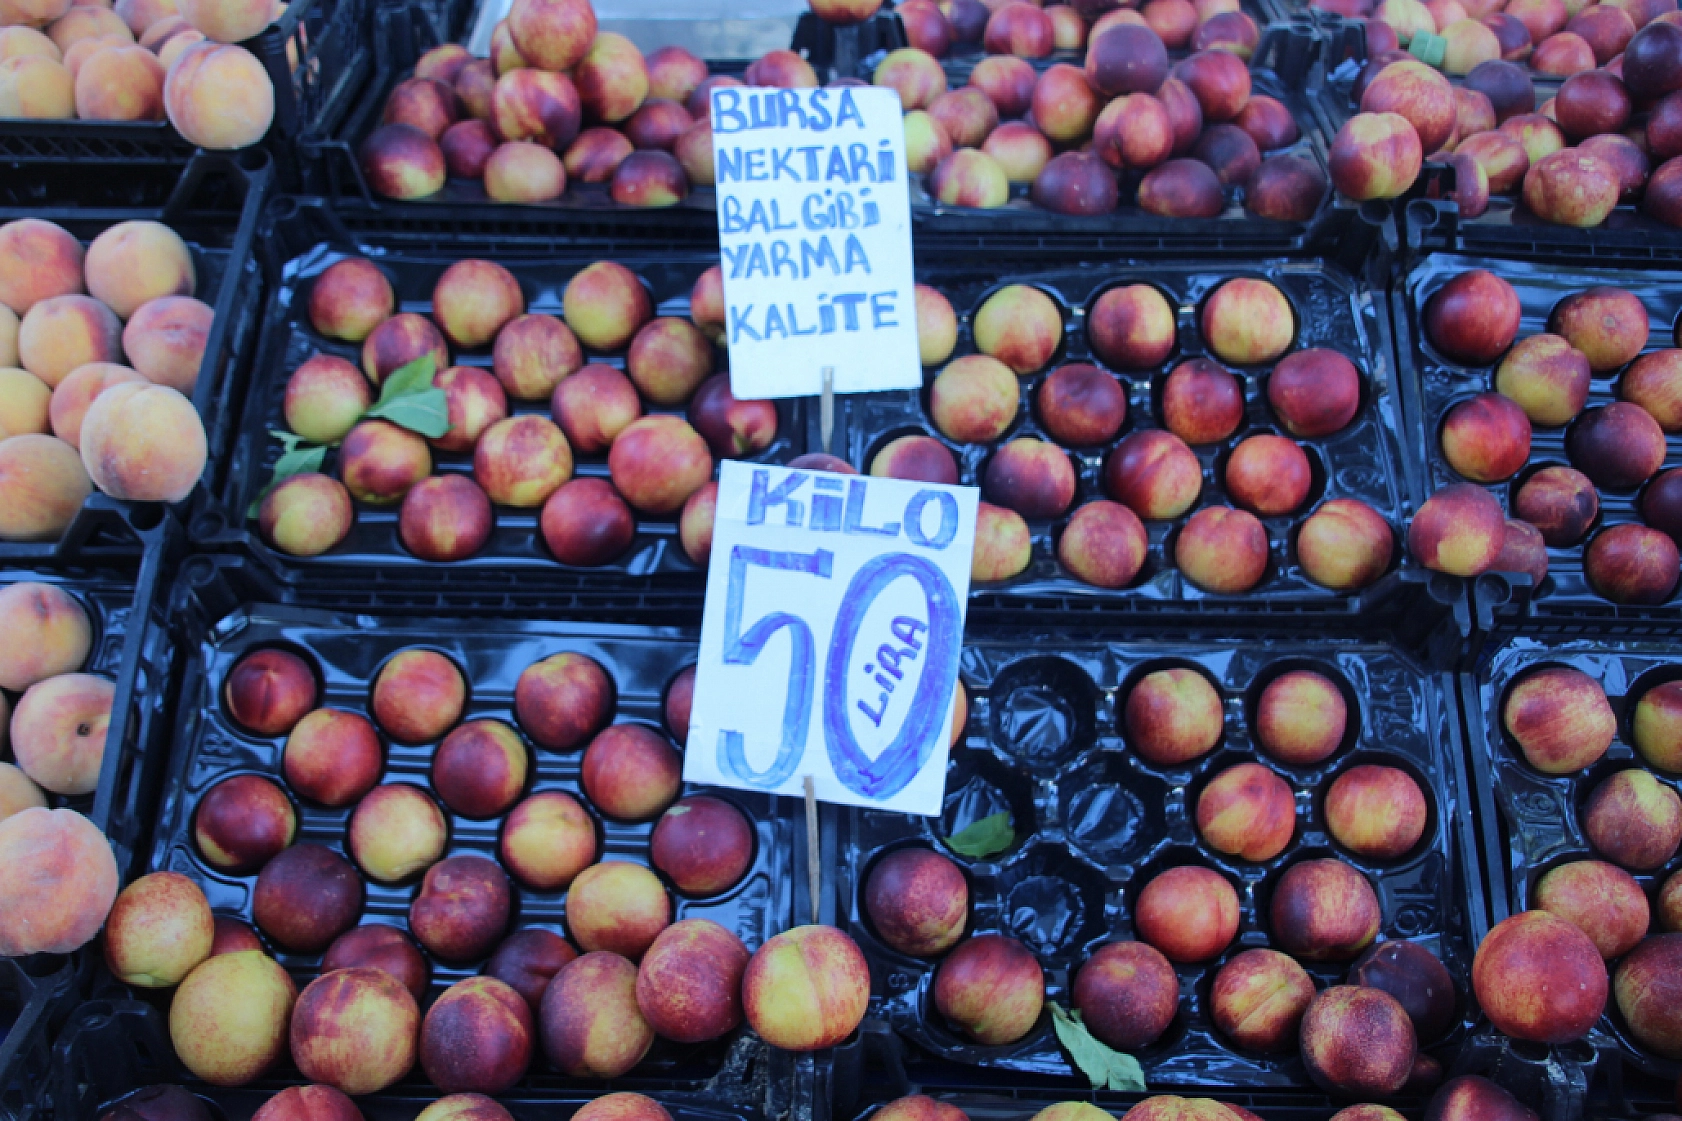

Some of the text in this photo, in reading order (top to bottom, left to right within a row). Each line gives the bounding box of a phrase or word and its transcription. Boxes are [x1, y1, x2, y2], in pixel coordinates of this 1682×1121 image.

[713, 88, 865, 133] BURSA
[722, 195, 797, 233] BAL
[722, 233, 871, 279] YARMA
[716, 544, 961, 801] 50
